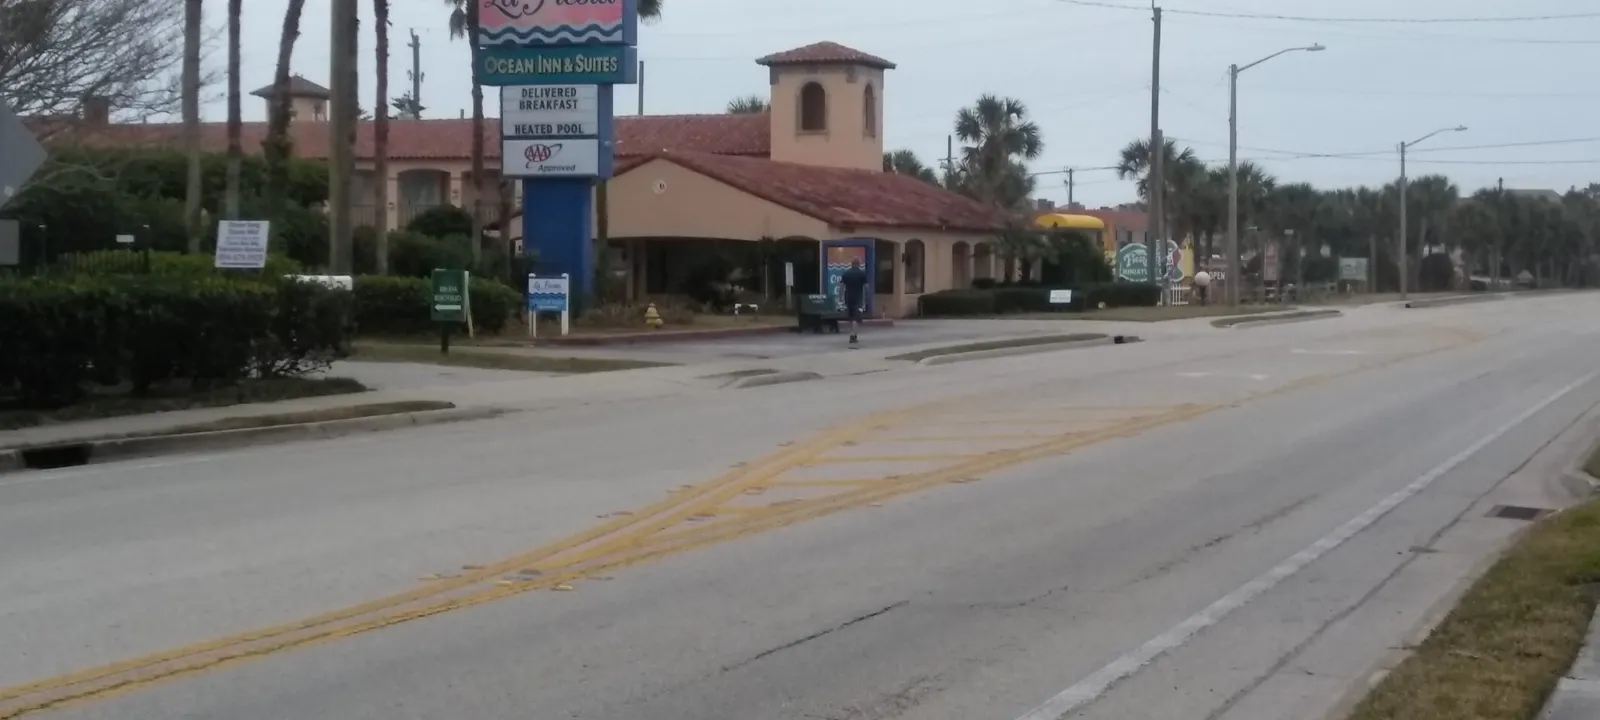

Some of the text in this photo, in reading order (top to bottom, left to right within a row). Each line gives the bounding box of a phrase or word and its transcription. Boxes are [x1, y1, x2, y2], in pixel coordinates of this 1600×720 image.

[484, 54, 618, 74] OCEAN INN & SUITES
[521, 87, 577, 98] DELIVERED
[519, 99, 578, 110] BREAKFAST
[514, 124, 585, 134] HEATED POOL
[526, 145, 550, 161] AAA
[538, 164, 576, 172] Approved
[1209, 271, 1225, 280] OPEN
